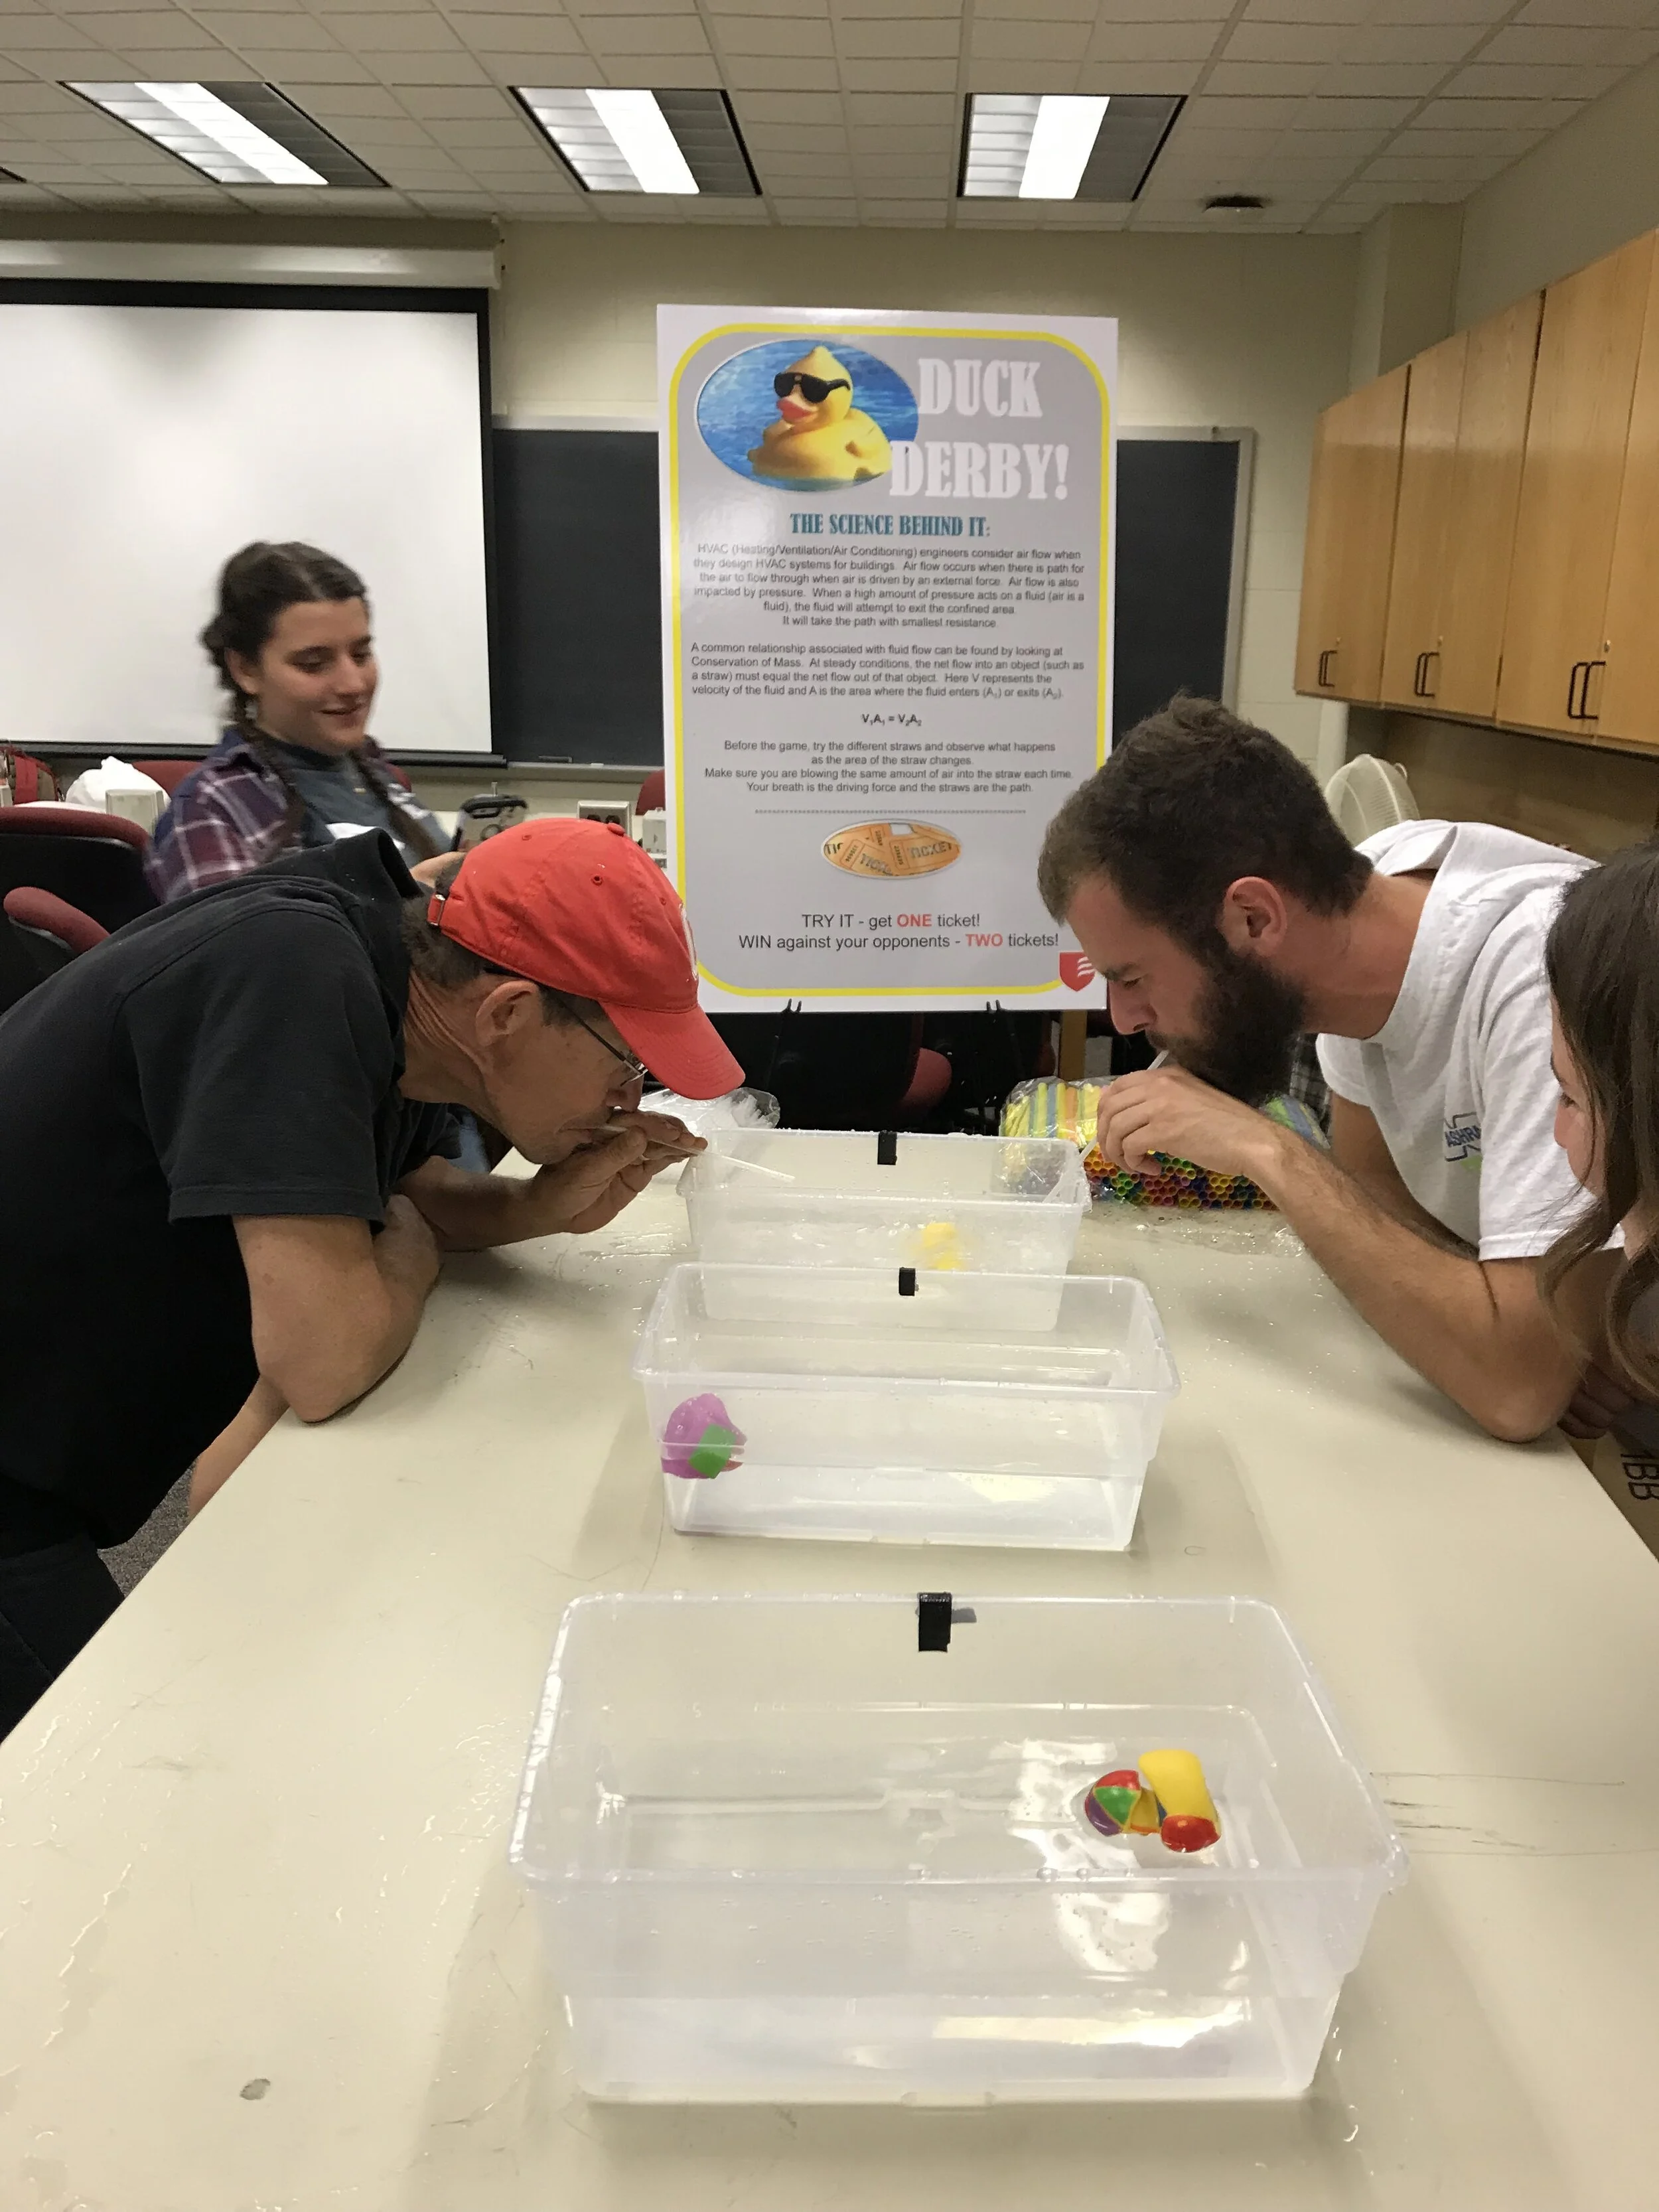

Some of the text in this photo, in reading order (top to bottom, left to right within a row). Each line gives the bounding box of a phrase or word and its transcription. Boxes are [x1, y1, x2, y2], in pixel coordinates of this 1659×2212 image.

[918, 358, 1043, 417] DUCK
[890, 441, 1069, 500] DERBY!
[789, 513, 989, 537] THE SCIENCE BEHIND IT:
[849, 546, 917, 559] Conditioning)
[918, 547, 969, 559] engineers
[971, 548, 1013, 558] consider
[1015, 549, 1029, 558] air
[1030, 549, 1051, 559] flow
[1053, 549, 1080, 559] when
[789, 560, 831, 571] systems
[833, 559, 847, 569] for
[902, 561, 917, 571] Air
[920, 561, 940, 571] flow
[978, 562, 1005, 572] when
[1007, 562, 1033, 572] there
[1046, 563, 1068, 575] path
[1070, 563, 1084, 573] for
[719, 572, 731, 582] air
[747, 572, 767, 582] flow
[770, 573, 809, 585] through
[812, 573, 839, 583] when
[842, 574, 855, 583] air
[869, 574, 899, 584] driven
[933, 575, 972, 585] external
[1008, 576, 1022, 586] Air
[1025, 577, 1045, 586] flow
[1058, 577, 1079, 587] also
[694, 586, 740, 599] impacted
[812, 588, 841, 598] When
[855, 588, 875, 600] high
[879, 589, 915, 599] amount
[931, 591, 974, 601] pressure
[977, 591, 997, 599] acts
[1025, 590, 1045, 600] fluid
[1048, 591, 1063, 603] (air
[813, 601, 833, 611] fluid
[837, 602, 852, 611] will
[855, 603, 893, 615] attempt
[908, 603, 926, 613] exit
[947, 603, 989, 613] confined
[792, 615, 808, 625] will
[810, 615, 832, 625] take
[853, 616, 875, 628] path
[879, 616, 899, 627] with
[901, 617, 942, 627] smallest
[748, 642, 806, 655] relationship
[808, 643, 862, 654] associated
[865, 644, 885, 654] with
[888, 644, 908, 654] fluid
[912, 644, 932, 654] flow
[955, 644, 968, 654] be
[970, 644, 998, 655] found
[1001, 645, 1013, 657] by
[1015, 645, 1050, 658] looking
[1053, 646, 1062, 656] at
[691, 656, 758, 667] Conservation
[810, 657, 820, 667] At
[824, 658, 855, 670] steady
[934, 660, 948, 668] net
[952, 658, 972, 668] flow
[975, 658, 992, 668] into
[1011, 659, 1039, 671] object
[1043, 659, 1069, 672] (such
[701, 670, 732, 683] straw)
[735, 672, 759, 681] must
[762, 671, 790, 683] equal
[811, 672, 828, 681] net
[830, 672, 851, 682] flow
[853, 672, 869, 682] out
[885, 672, 902, 682] that
[944, 672, 968, 682] Here
[982, 674, 1033, 685] represents
[691, 685, 730, 697] velocity
[764, 686, 784, 695] fluid
[787, 686, 806, 695] and
[874, 686, 904, 696] where
[925, 686, 946, 696] fluid
[948, 687, 979, 696] enters
[1017, 687, 1039, 697] exits
[724, 740, 757, 750] Before
[812, 741, 826, 753] try
[846, 741, 887, 751] different
[890, 742, 921, 751] straws
[924, 741, 942, 751] and
[945, 741, 985, 751] observe
[987, 741, 1011, 751] what
[1013, 741, 1055, 753] happens
[826, 754, 841, 764] the
[882, 755, 897, 765] the
[901, 756, 926, 765] straw
[703, 768, 732, 778] Make
[760, 771, 778, 780] you
[800, 768, 837, 780] blowing
[889, 769, 926, 778] amount
[942, 768, 953, 778] air
[956, 769, 974, 778] into
[995, 769, 1021, 778] straw
[1023, 769, 1047, 778] each
[747, 781, 768, 791] Your
[772, 781, 803, 791] breath
[836, 782, 868, 794] driving
[872, 782, 896, 792] force
[899, 782, 917, 792] and
[938, 783, 970, 792] straws
[801, 913, 979, 930] TRY IT get ONE ticket!
[739, 933, 1058, 951] WIN against your opponents TWO tickets!
